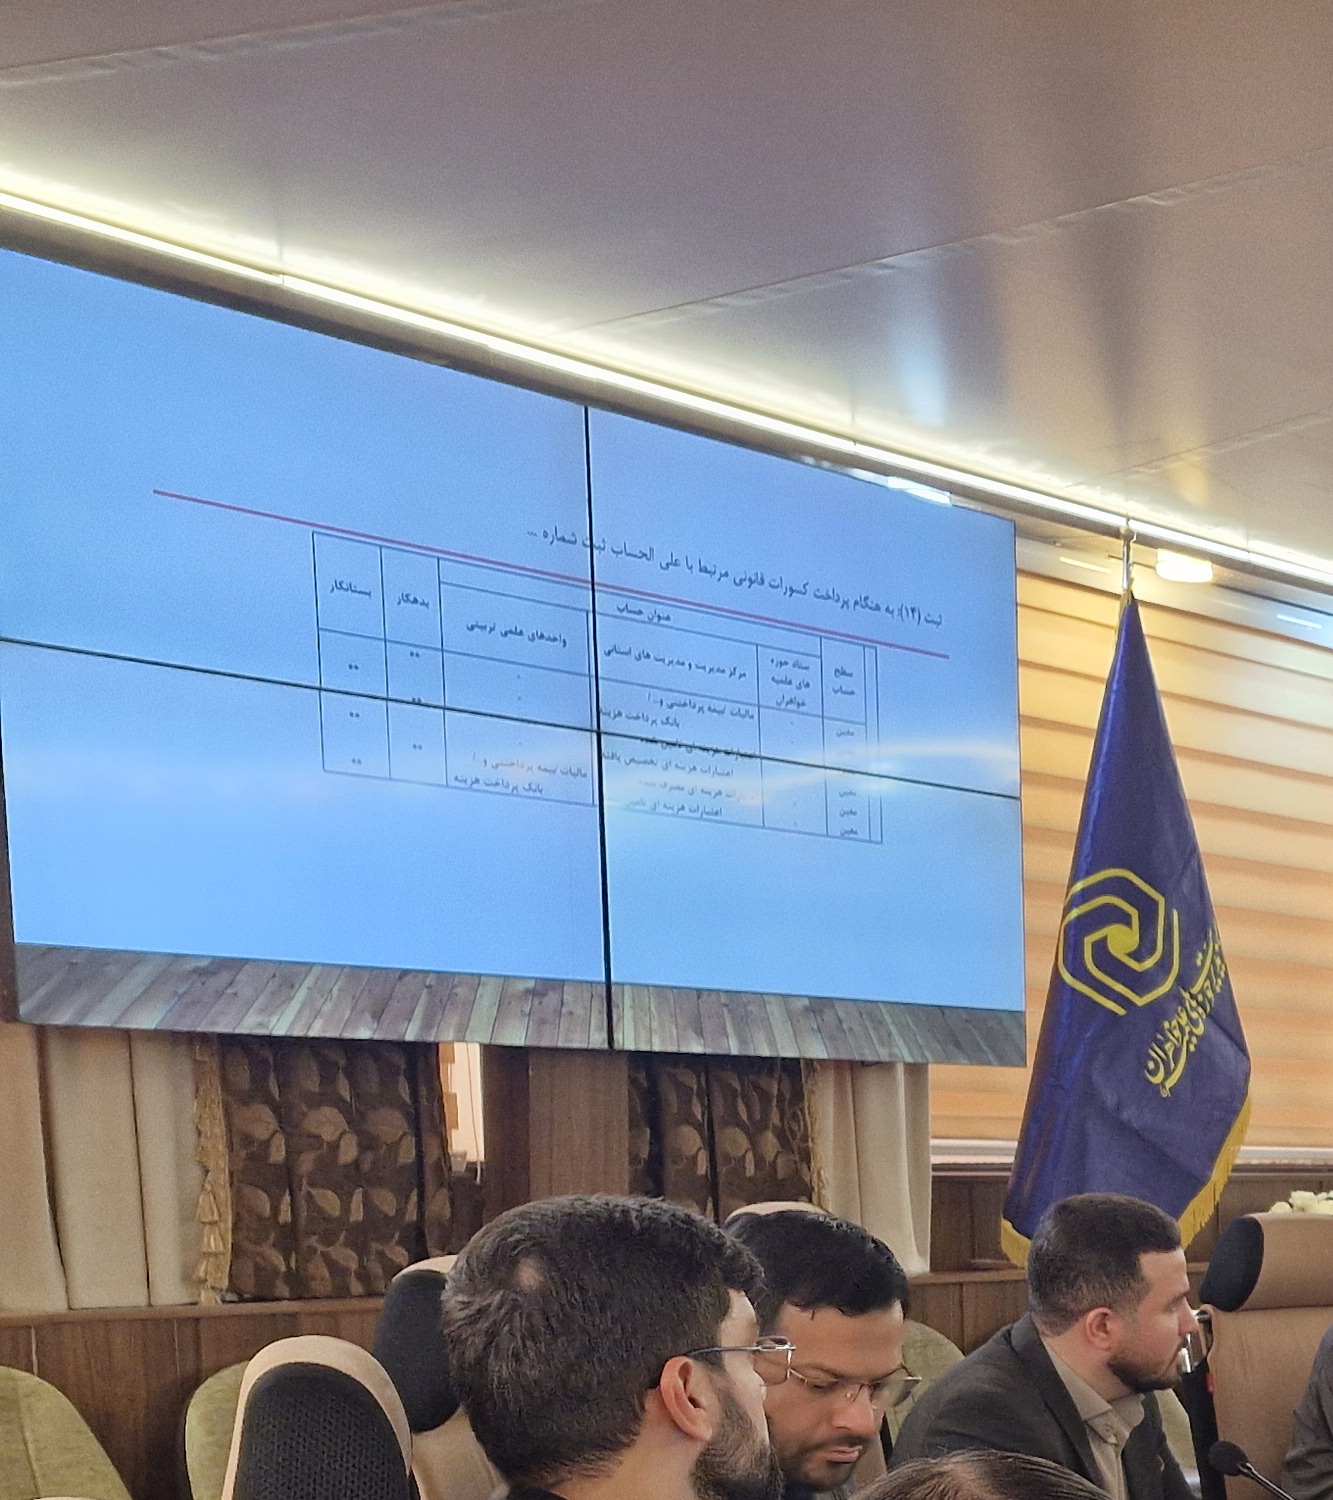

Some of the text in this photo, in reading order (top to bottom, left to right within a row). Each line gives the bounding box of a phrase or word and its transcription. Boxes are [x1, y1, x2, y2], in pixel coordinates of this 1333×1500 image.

[542, 525, 578, 546] شماره
[610, 542, 655, 562] الحساب
[659, 551, 681, 571] علی
[684, 554, 694, 574] با
[698, 558, 729, 583] مرتبط
[329, 578, 372, 599] بستانکار
[733, 570, 765, 589] قانونی
[768, 576, 809, 598] کسورات
[396, 592, 430, 610] بدهکار
[813, 587, 850, 610] پرداخت
[853, 595, 882, 612] هنگام
